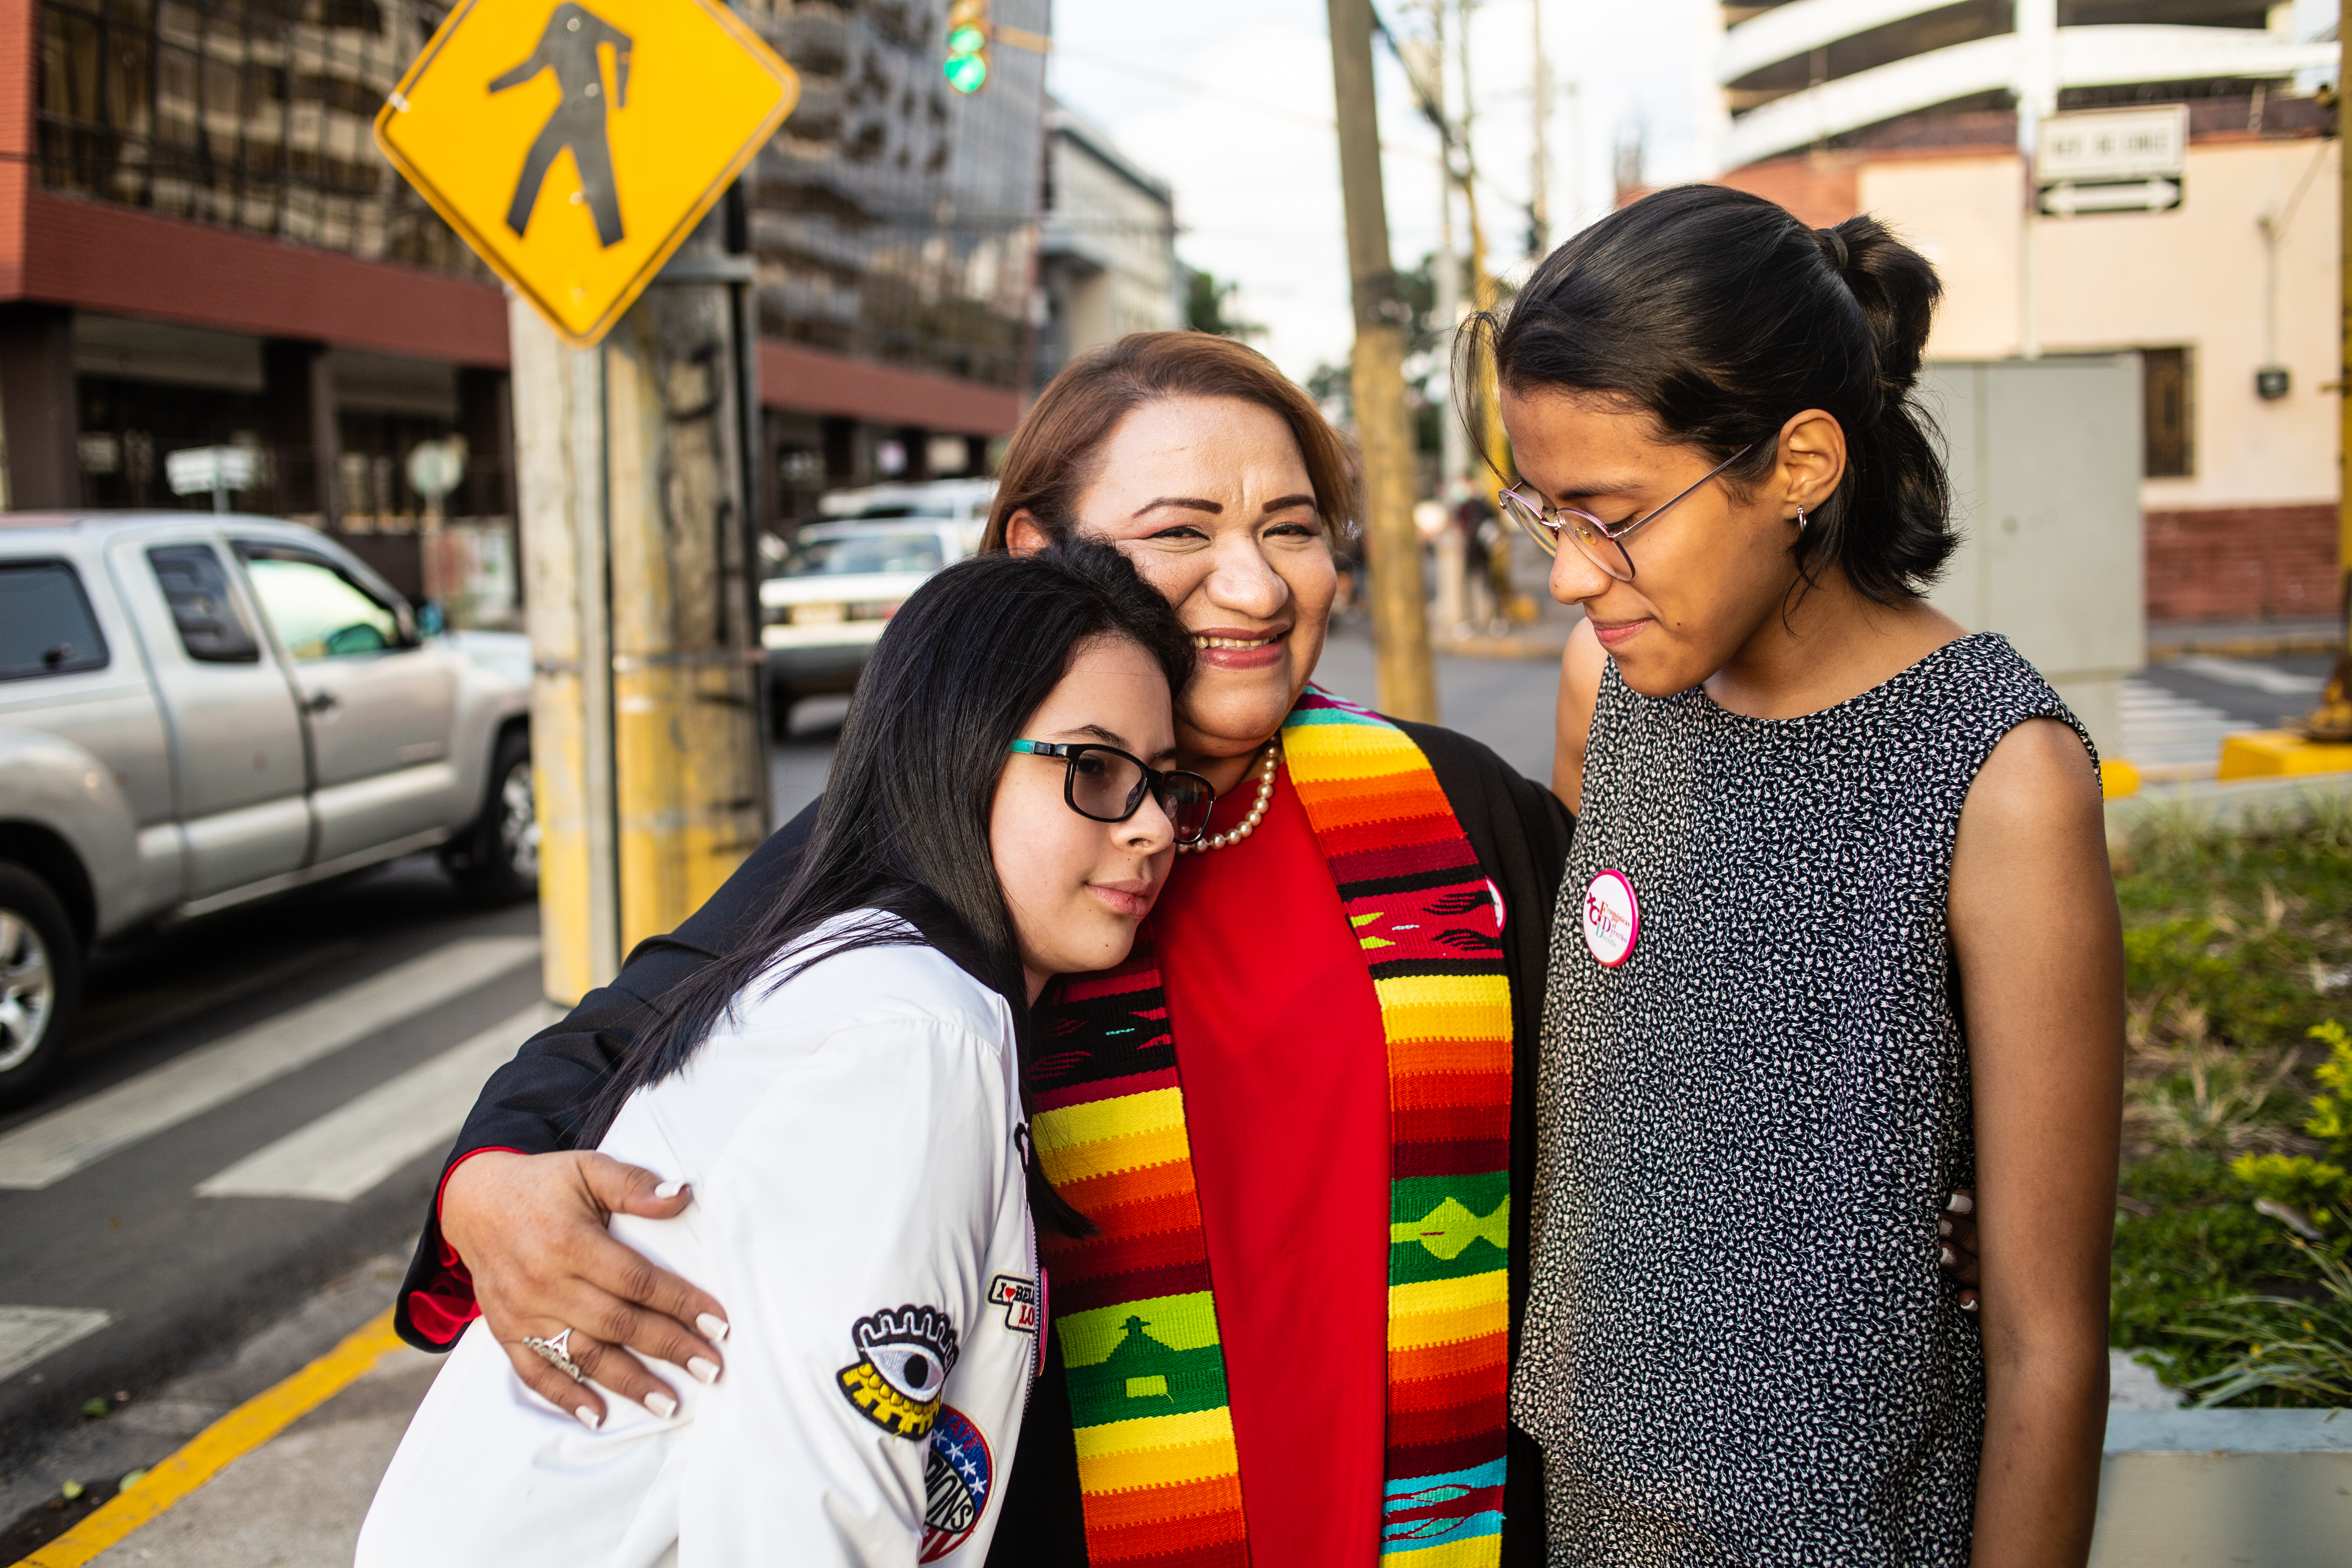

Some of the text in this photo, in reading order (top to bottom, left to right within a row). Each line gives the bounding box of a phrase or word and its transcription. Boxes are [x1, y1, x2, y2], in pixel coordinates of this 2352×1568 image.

[1599, 900, 1630, 927] Ecuménicas
[1595, 922, 1617, 948] Decidir
[1602, 916, 1627, 943] Derecho
[997, 1282, 1007, 1298] I
[937, 1410, 978, 1454] TATE
